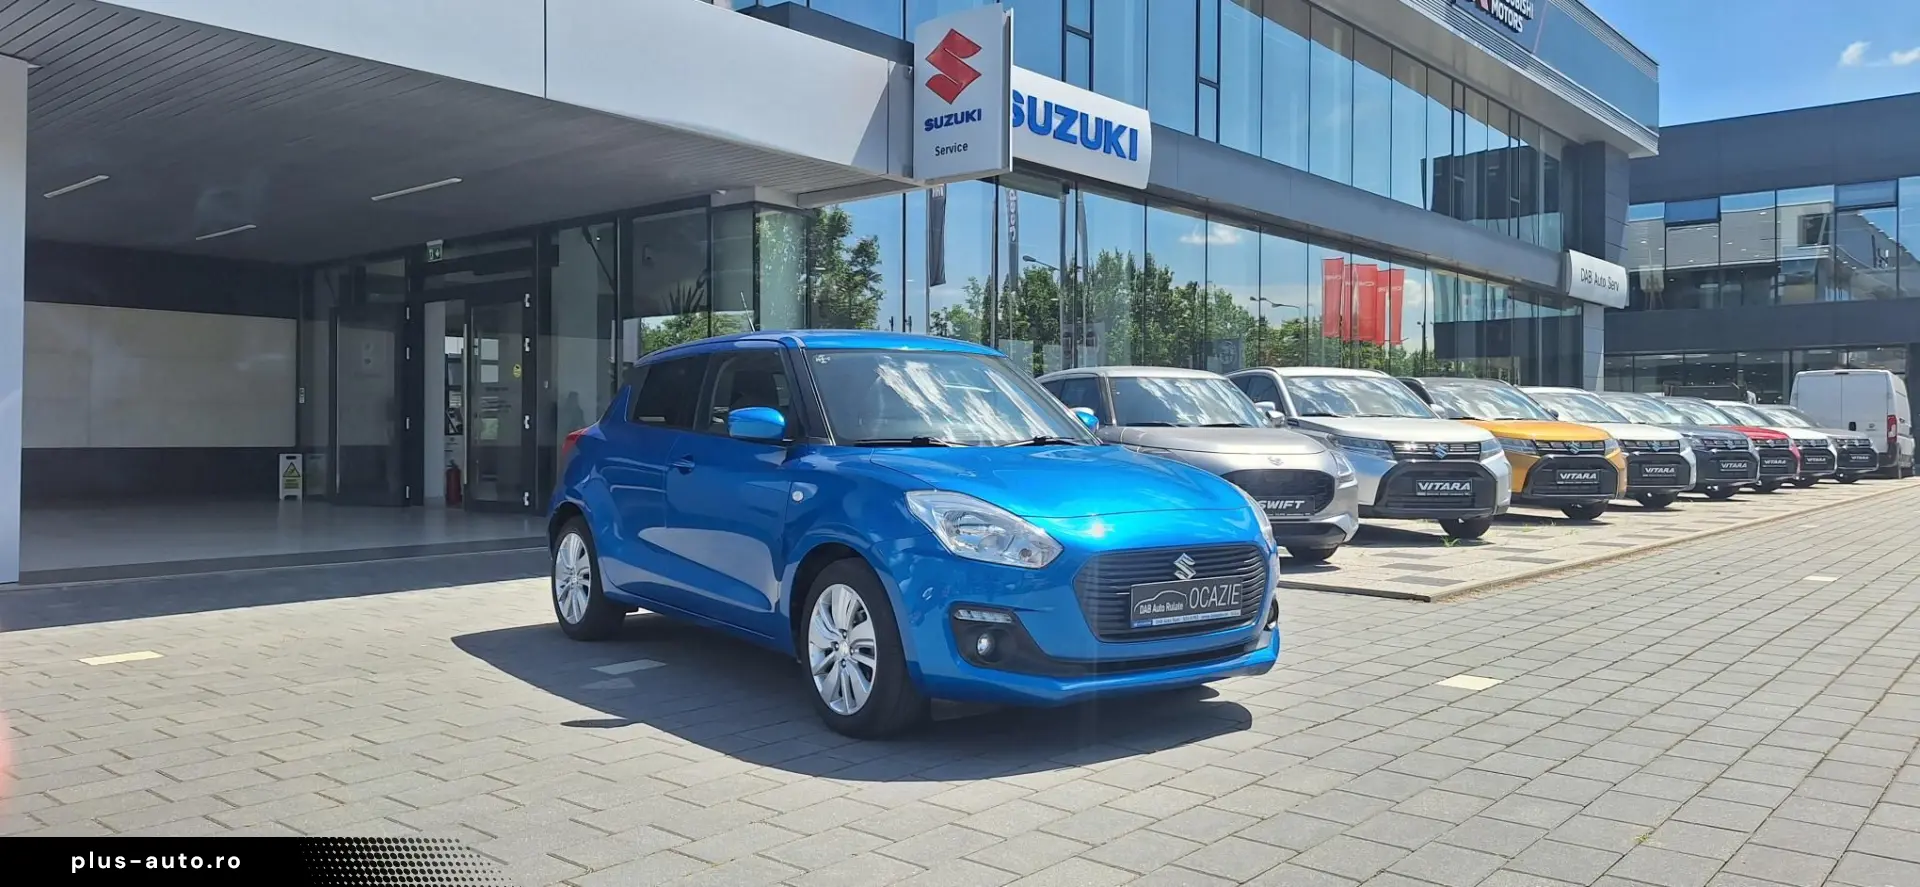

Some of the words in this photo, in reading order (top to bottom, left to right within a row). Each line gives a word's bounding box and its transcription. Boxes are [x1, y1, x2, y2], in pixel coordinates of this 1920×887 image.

[1491, 0, 1523, 33] MOTORS
[924, 108, 982, 132] SUZUKI
[1013, 89, 1138, 161] SUZUKI
[934, 141, 968, 157] Service
[1580, 268, 1592, 284] DAB
[1594, 273, 1607, 288] Auto
[1607, 276, 1619, 291] Serv
[1560, 472, 1597, 480] VITARA
[1418, 482, 1470, 491] VITARA
[1258, 500, 1305, 510] SWIFT
[1189, 584, 1241, 609] OCAZIE
[1140, 604, 1151, 614] DAB
[1152, 603, 1165, 613] Auto
